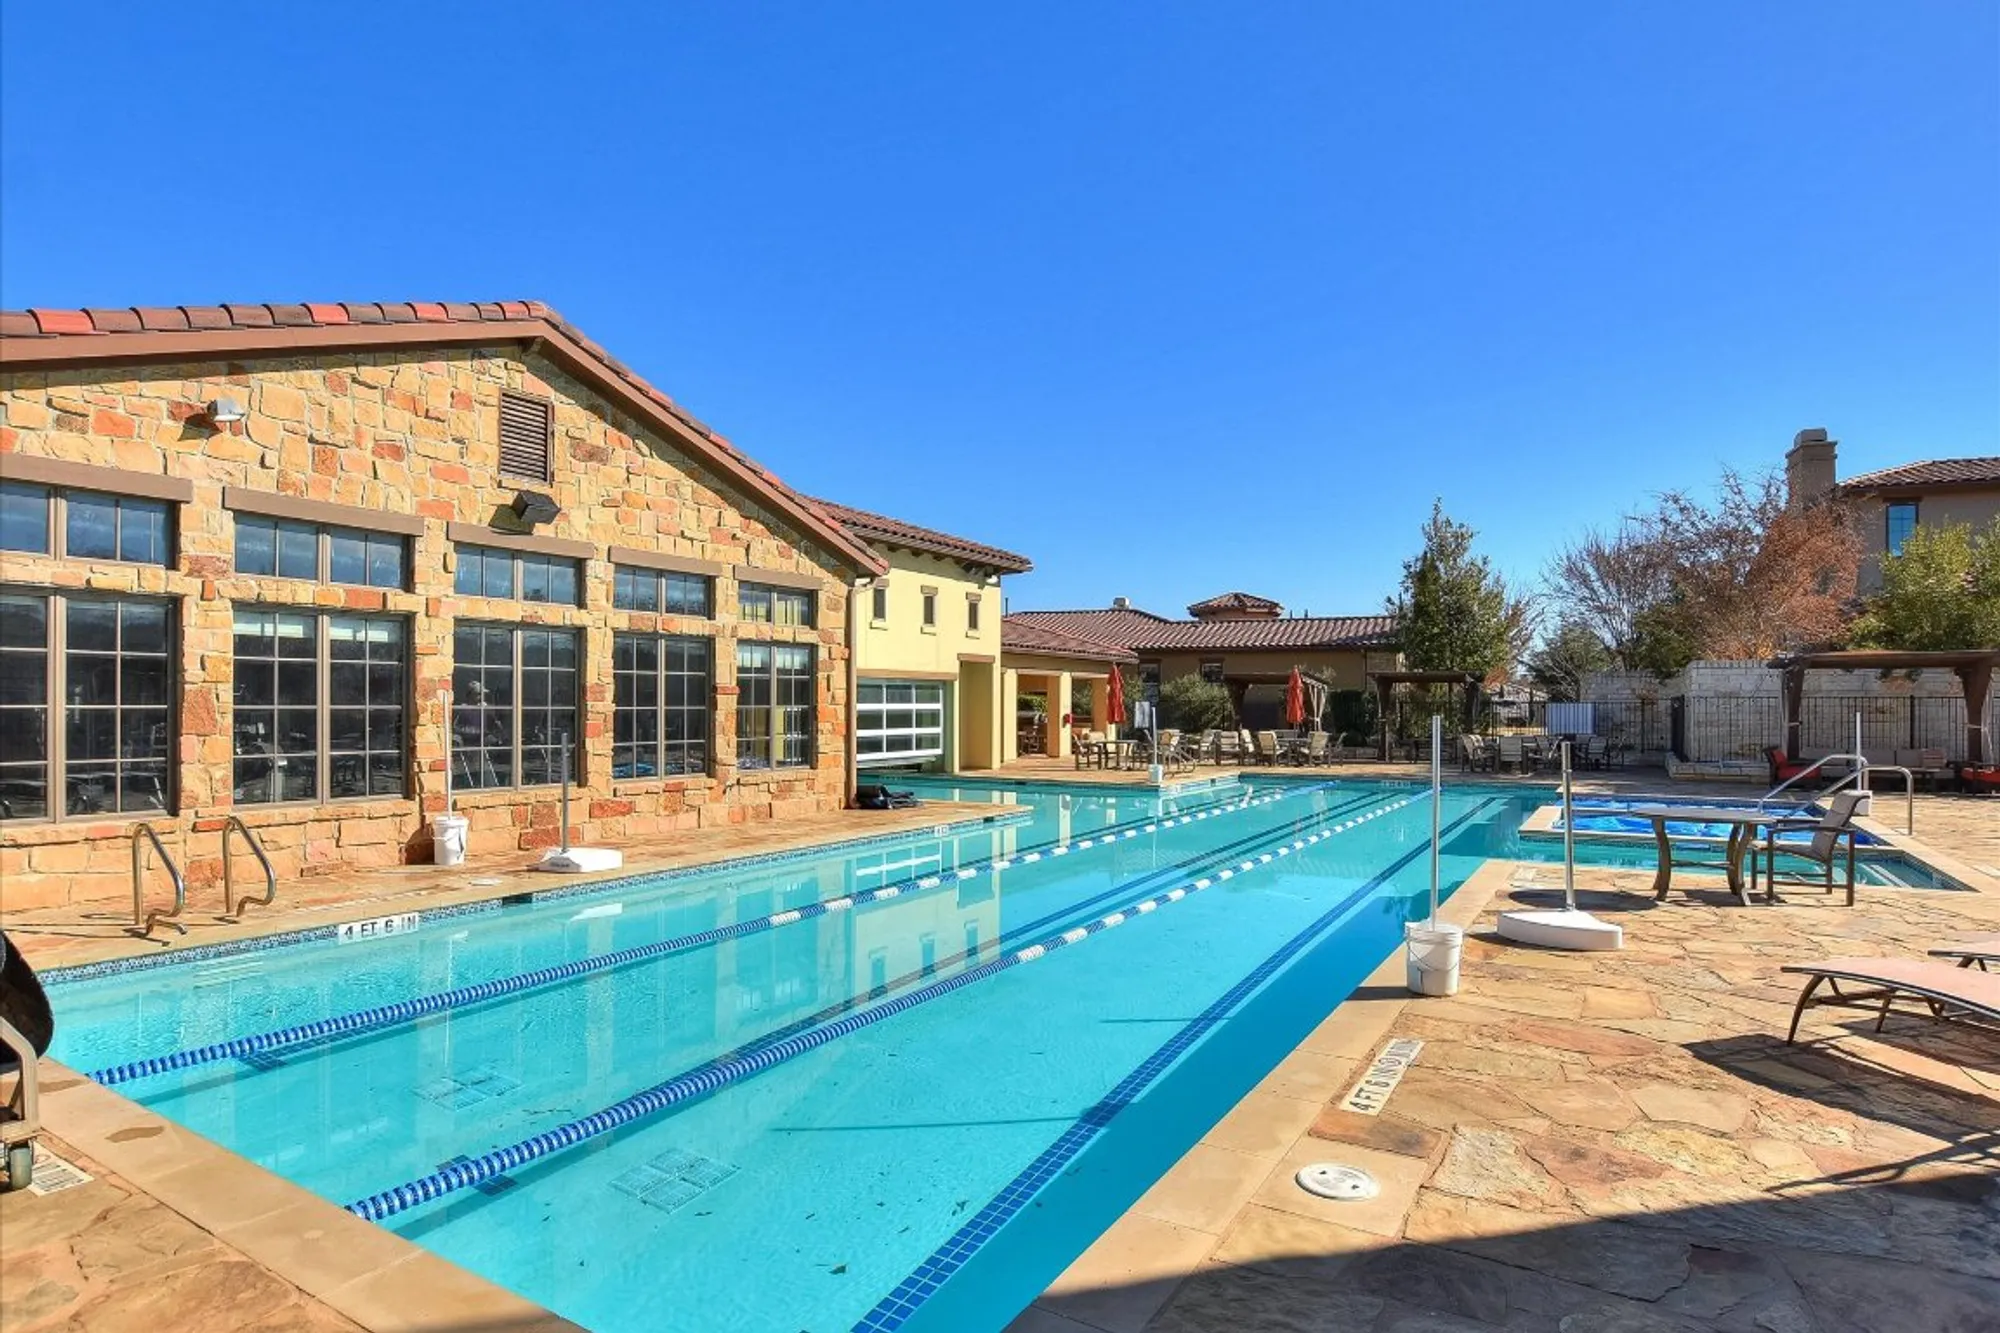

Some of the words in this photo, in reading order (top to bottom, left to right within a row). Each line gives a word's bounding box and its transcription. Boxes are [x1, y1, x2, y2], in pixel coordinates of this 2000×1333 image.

[361, 921, 378, 938] FT
[401, 914, 416, 930] IN
[1354, 1087, 1385, 1102] FT
